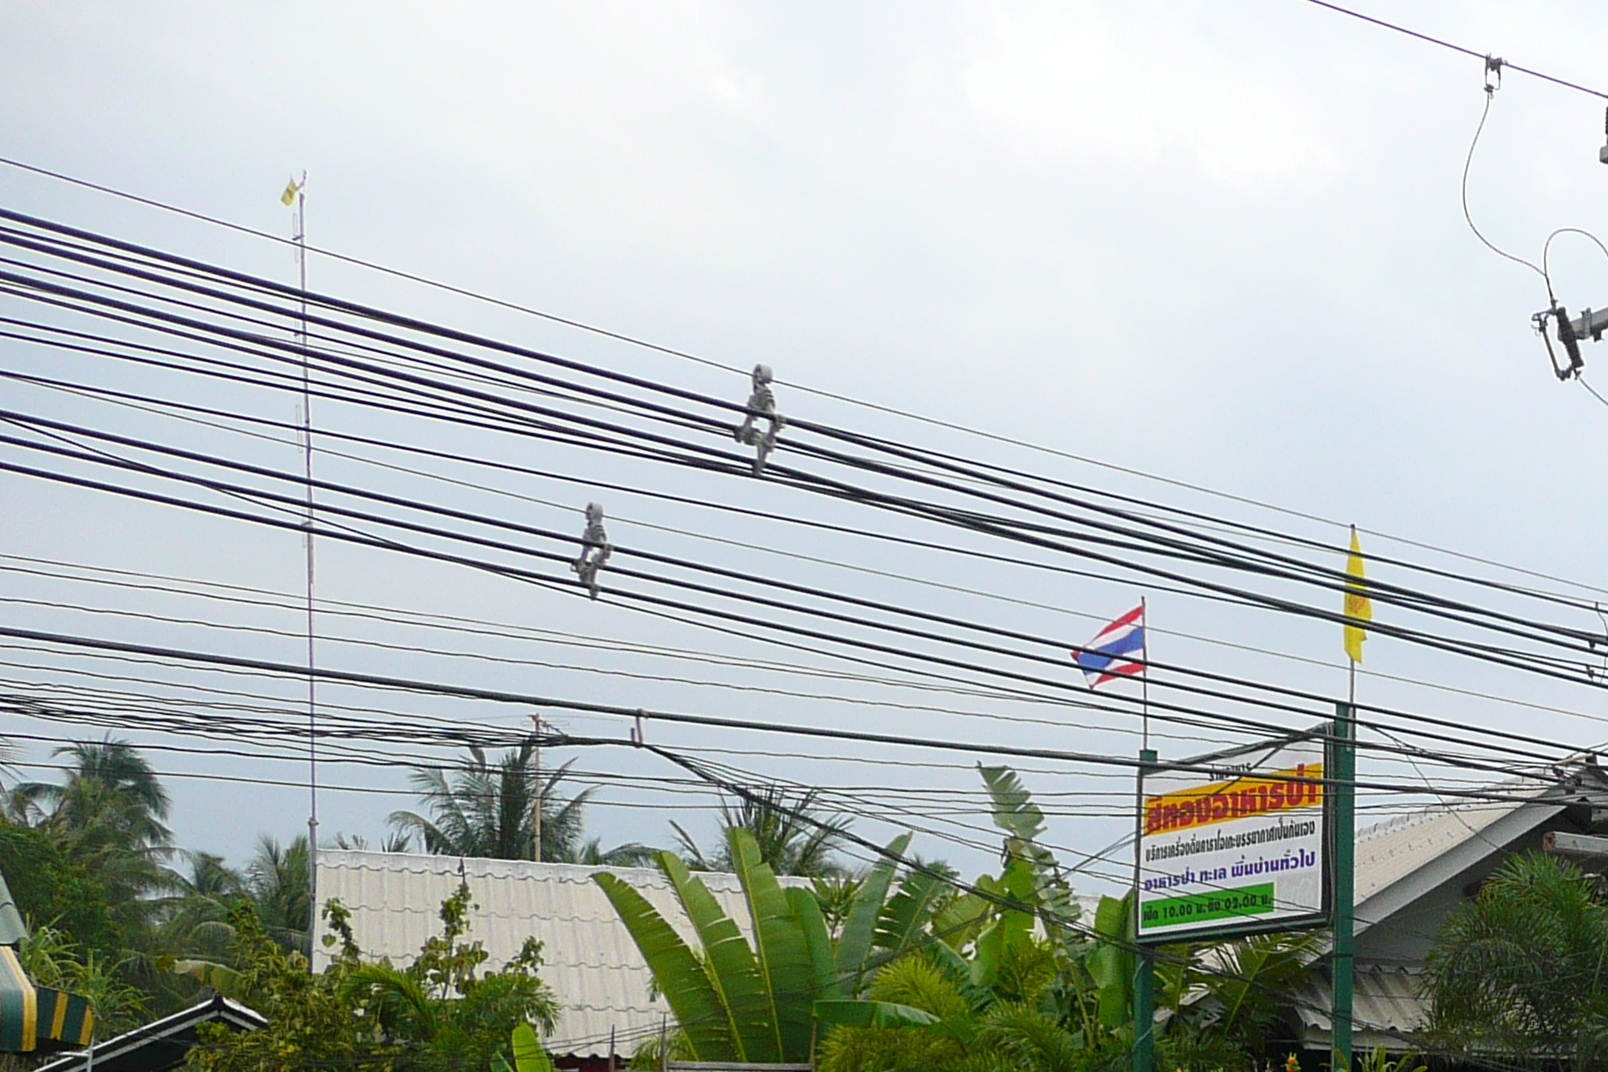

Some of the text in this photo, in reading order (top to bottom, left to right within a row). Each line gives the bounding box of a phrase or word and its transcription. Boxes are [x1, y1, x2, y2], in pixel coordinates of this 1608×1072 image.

[1144, 848, 1316, 891] อาหารป่า ทะเล พื้นบ้านทั่วไป
[1163, 903, 1193, 918] 10.00
[1224, 894, 1257, 910] 02.00
